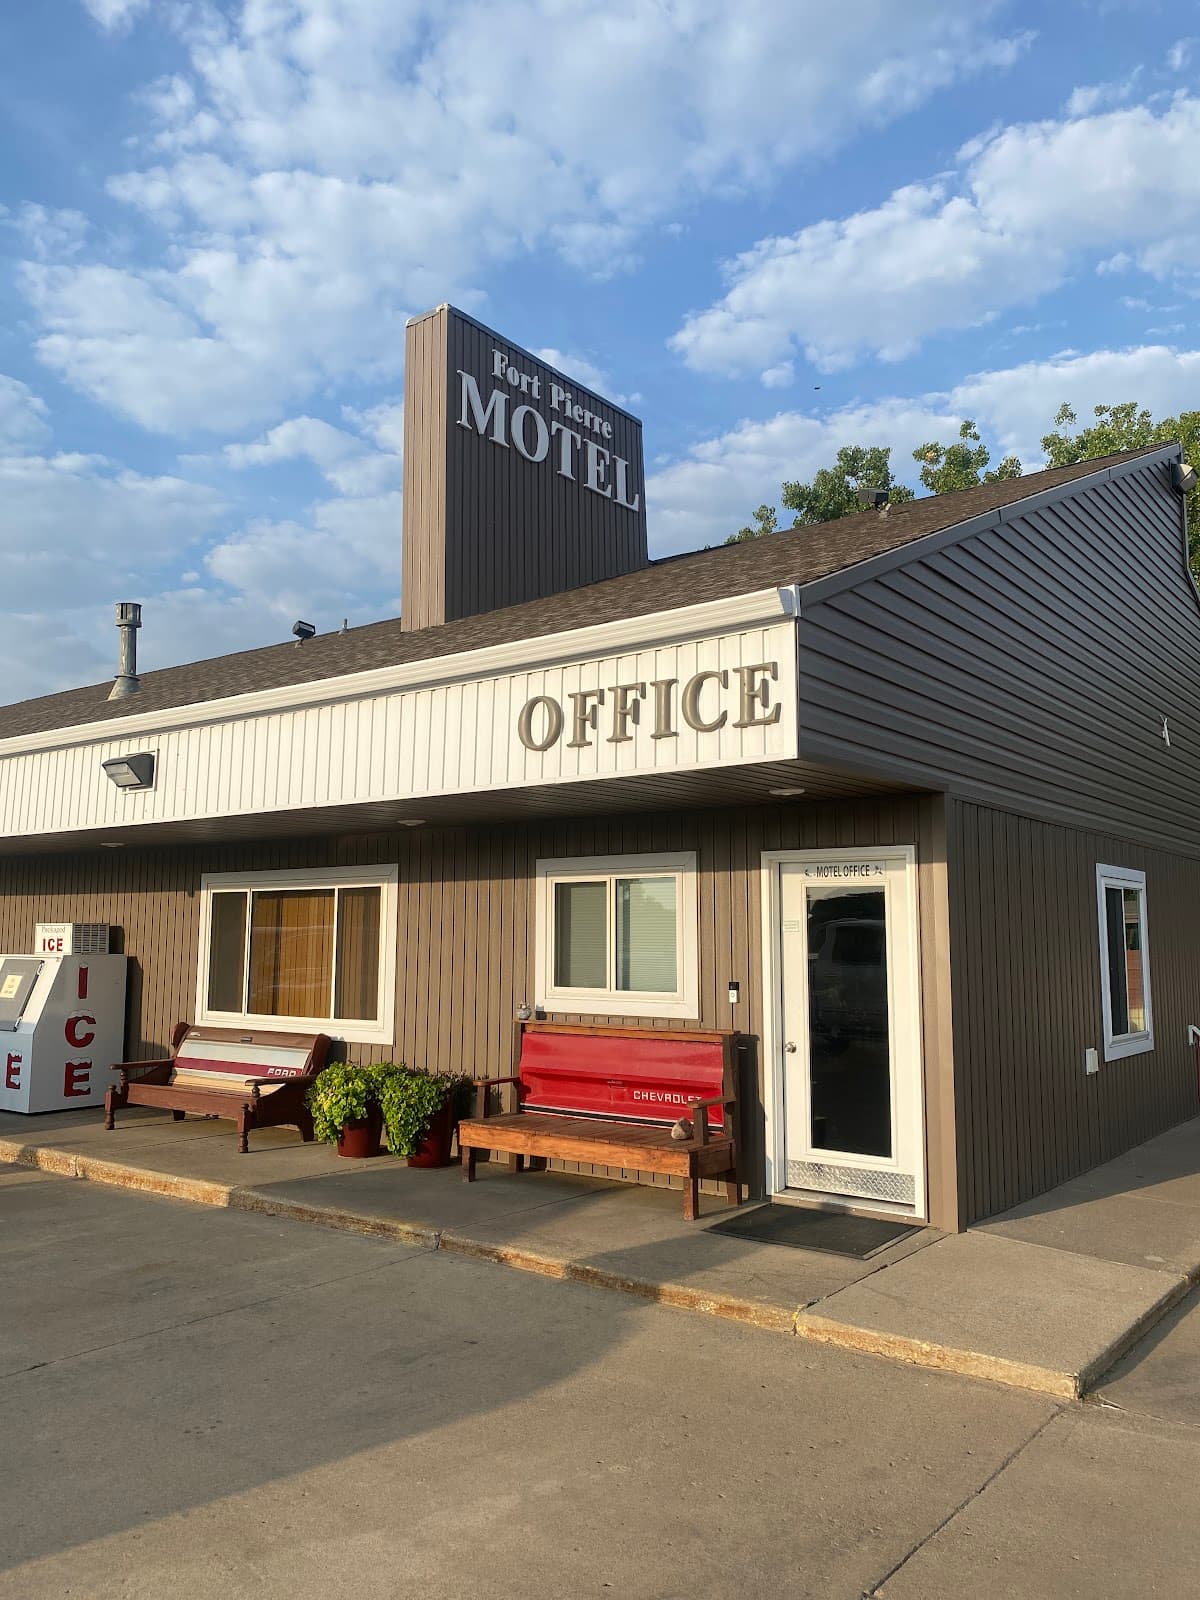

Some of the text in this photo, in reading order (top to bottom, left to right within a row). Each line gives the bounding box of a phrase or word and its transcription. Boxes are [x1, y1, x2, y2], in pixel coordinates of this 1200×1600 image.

[492, 349, 612, 439] Fort Pierre
[456, 370, 639, 512] MOTEL
[518, 661, 781, 752] OFFICE
[816, 864, 870, 878] MOTEL OFFICE
[42, 938, 64, 952] ICE
[64, 964, 97, 1097] ICE
[267, 1068, 297, 1077] FORD
